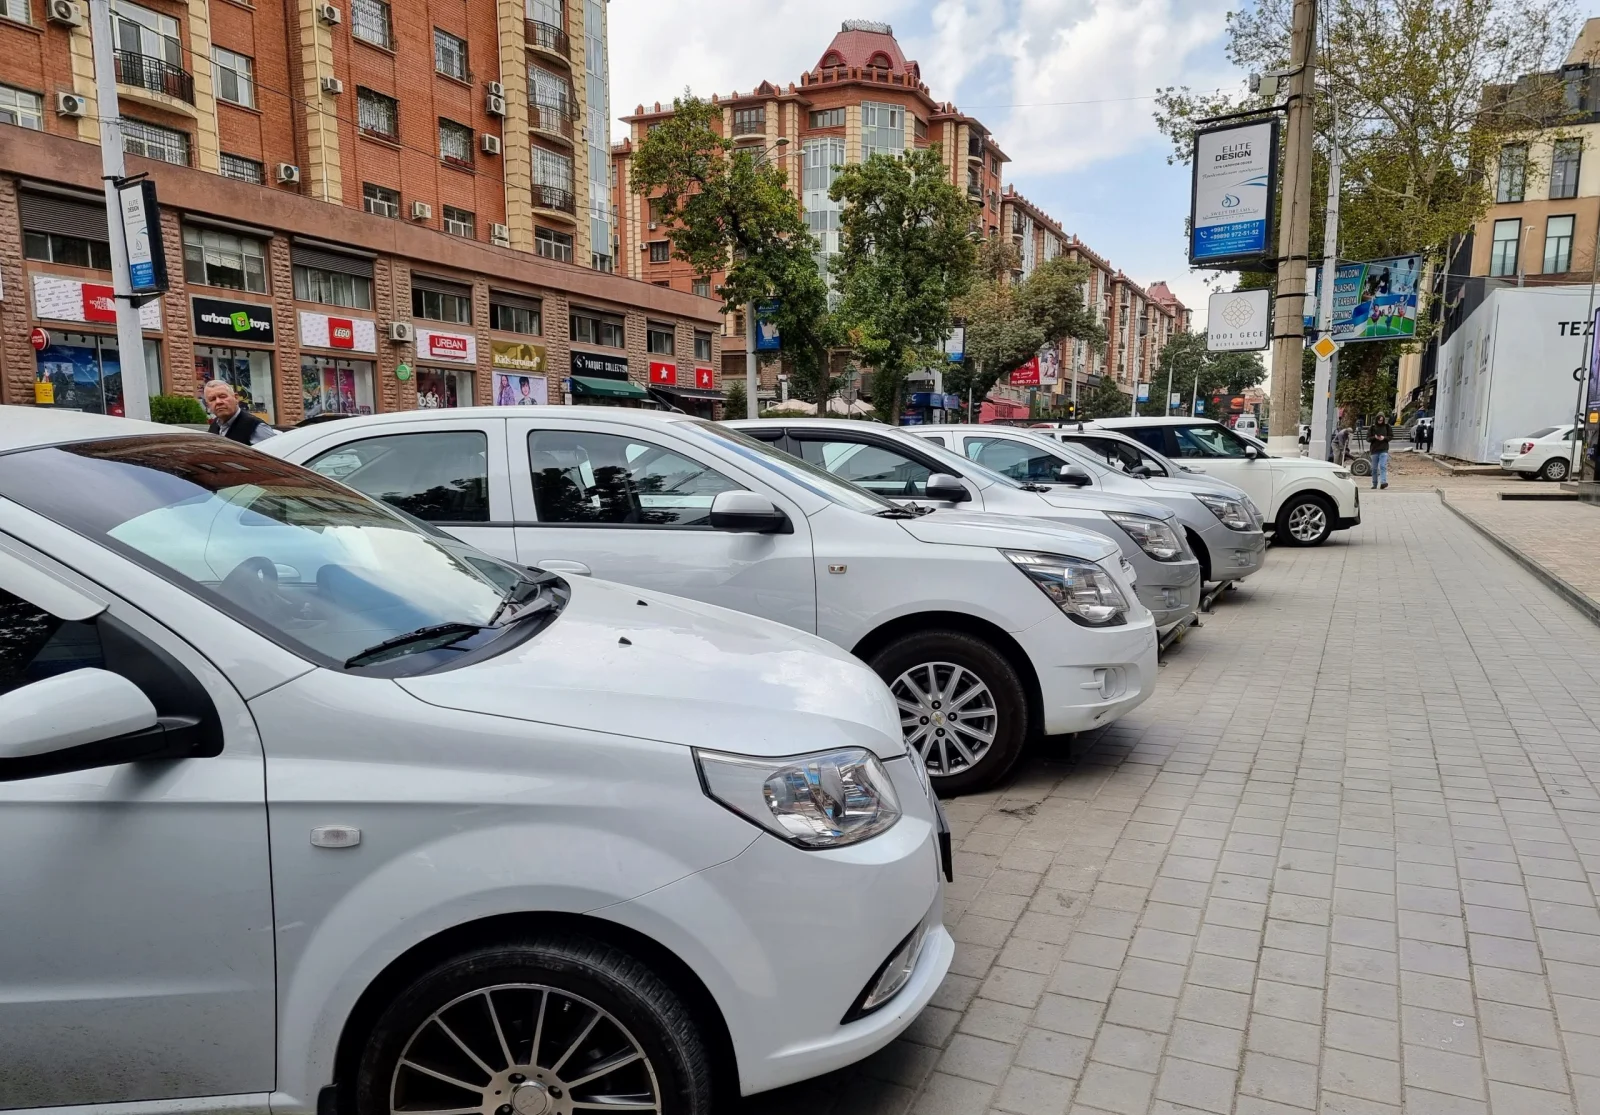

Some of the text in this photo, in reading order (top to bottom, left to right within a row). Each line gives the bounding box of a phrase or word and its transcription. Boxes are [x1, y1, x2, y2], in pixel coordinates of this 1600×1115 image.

[1222, 142, 1252, 153] ELITE
[1215, 150, 1252, 162] DESIGN
[201, 312, 271, 331] urban toys
[334, 328, 351, 339] LEGO
[1210, 330, 1264, 340] 1001 GECE
[435, 337, 464, 350] URBAN
[585, 359, 604, 371] PARQUET
